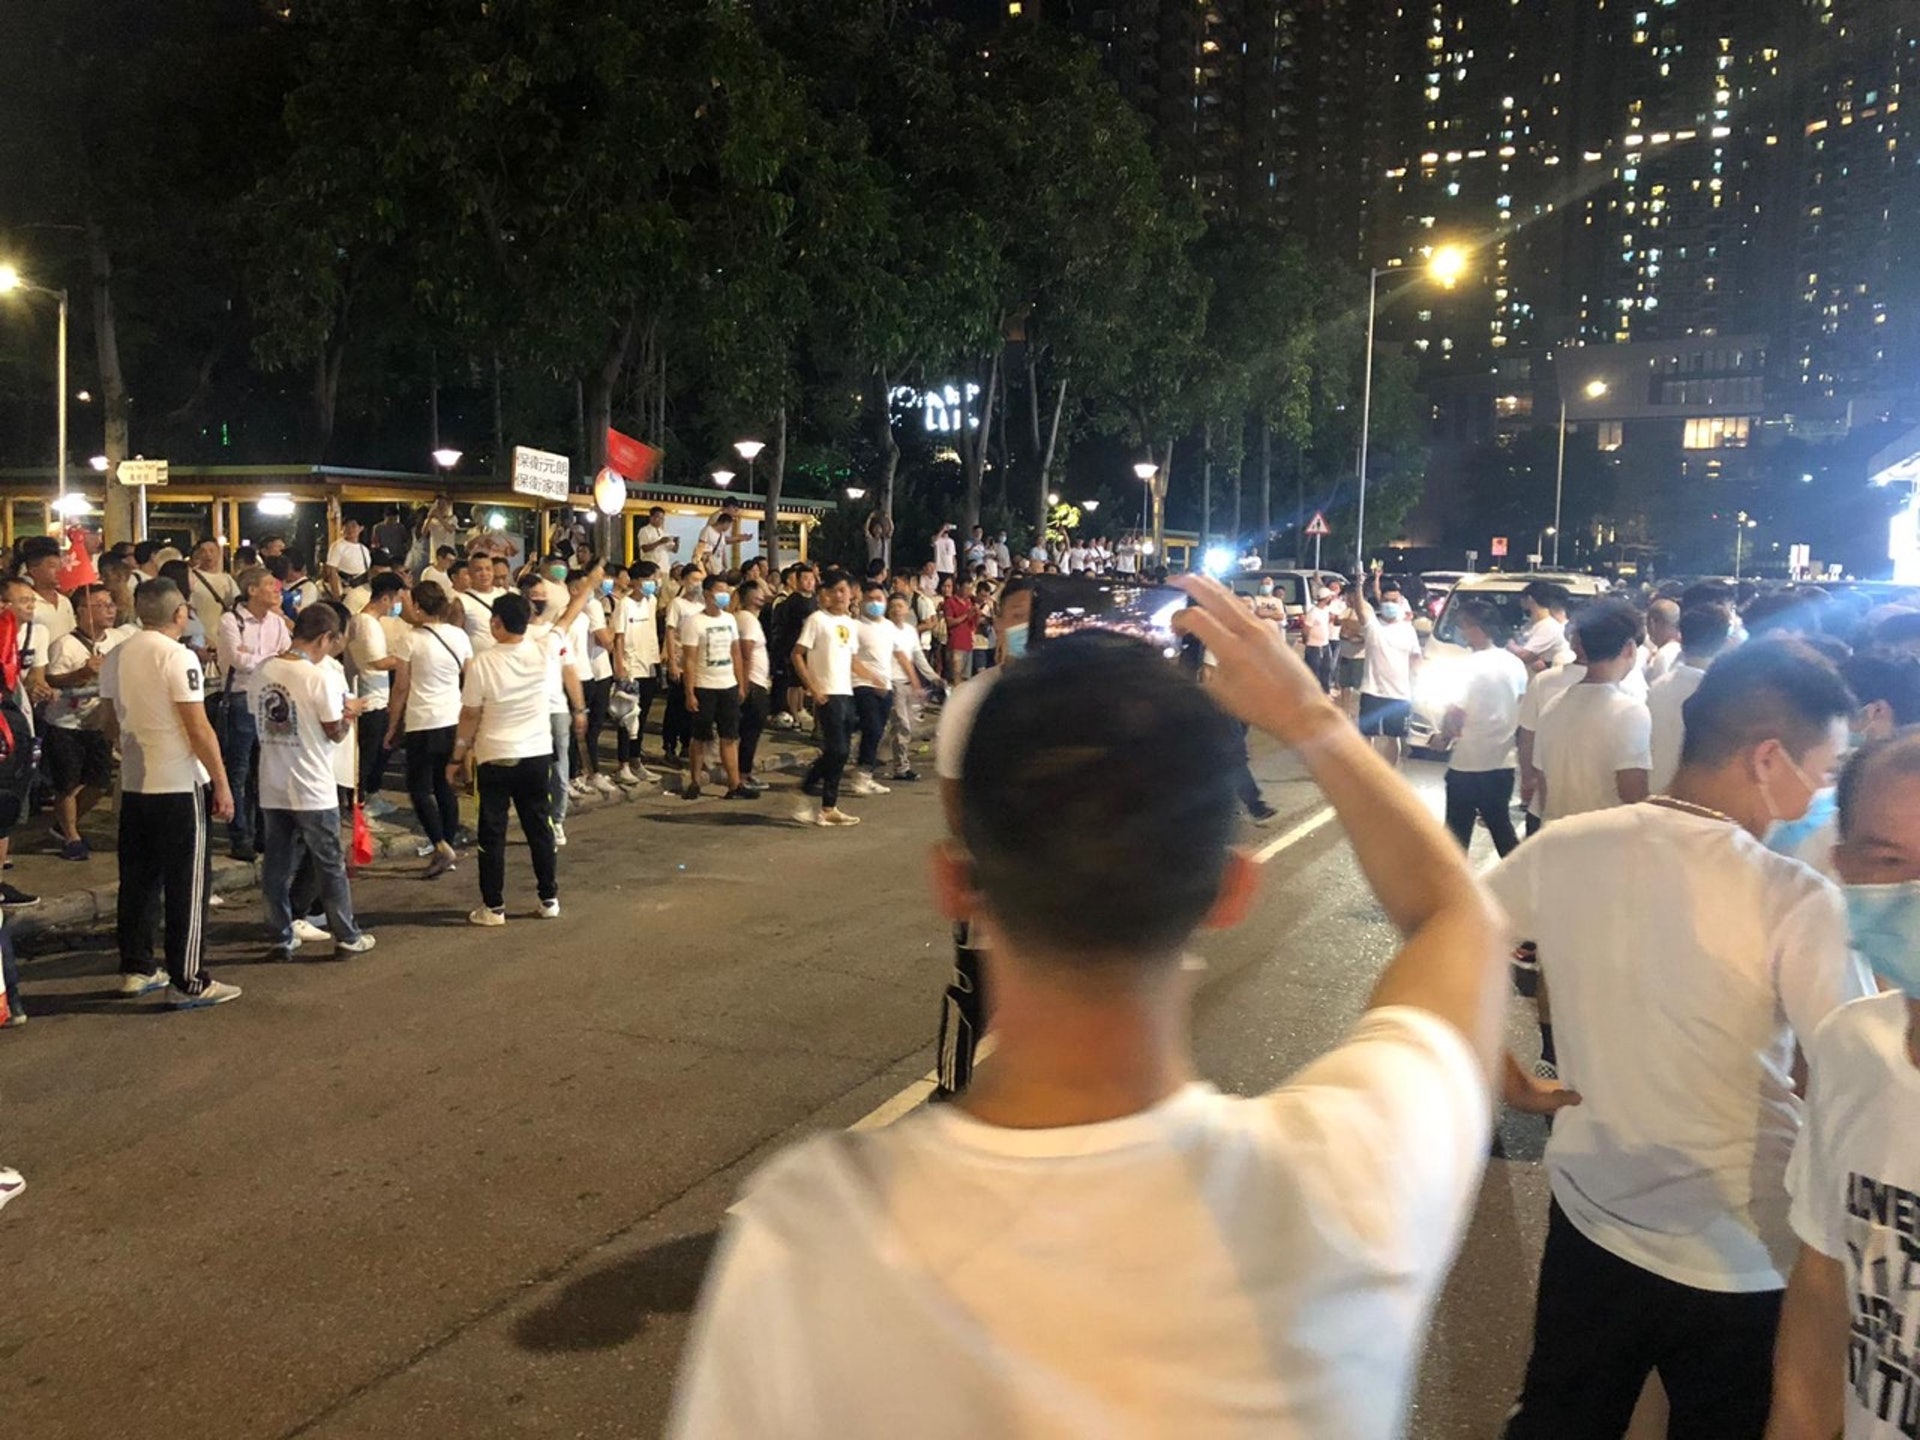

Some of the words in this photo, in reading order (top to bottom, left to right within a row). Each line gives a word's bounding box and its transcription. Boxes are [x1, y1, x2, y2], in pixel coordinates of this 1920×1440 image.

[518, 452, 568, 477] 保衛元朗
[186, 668, 200, 690] 8
